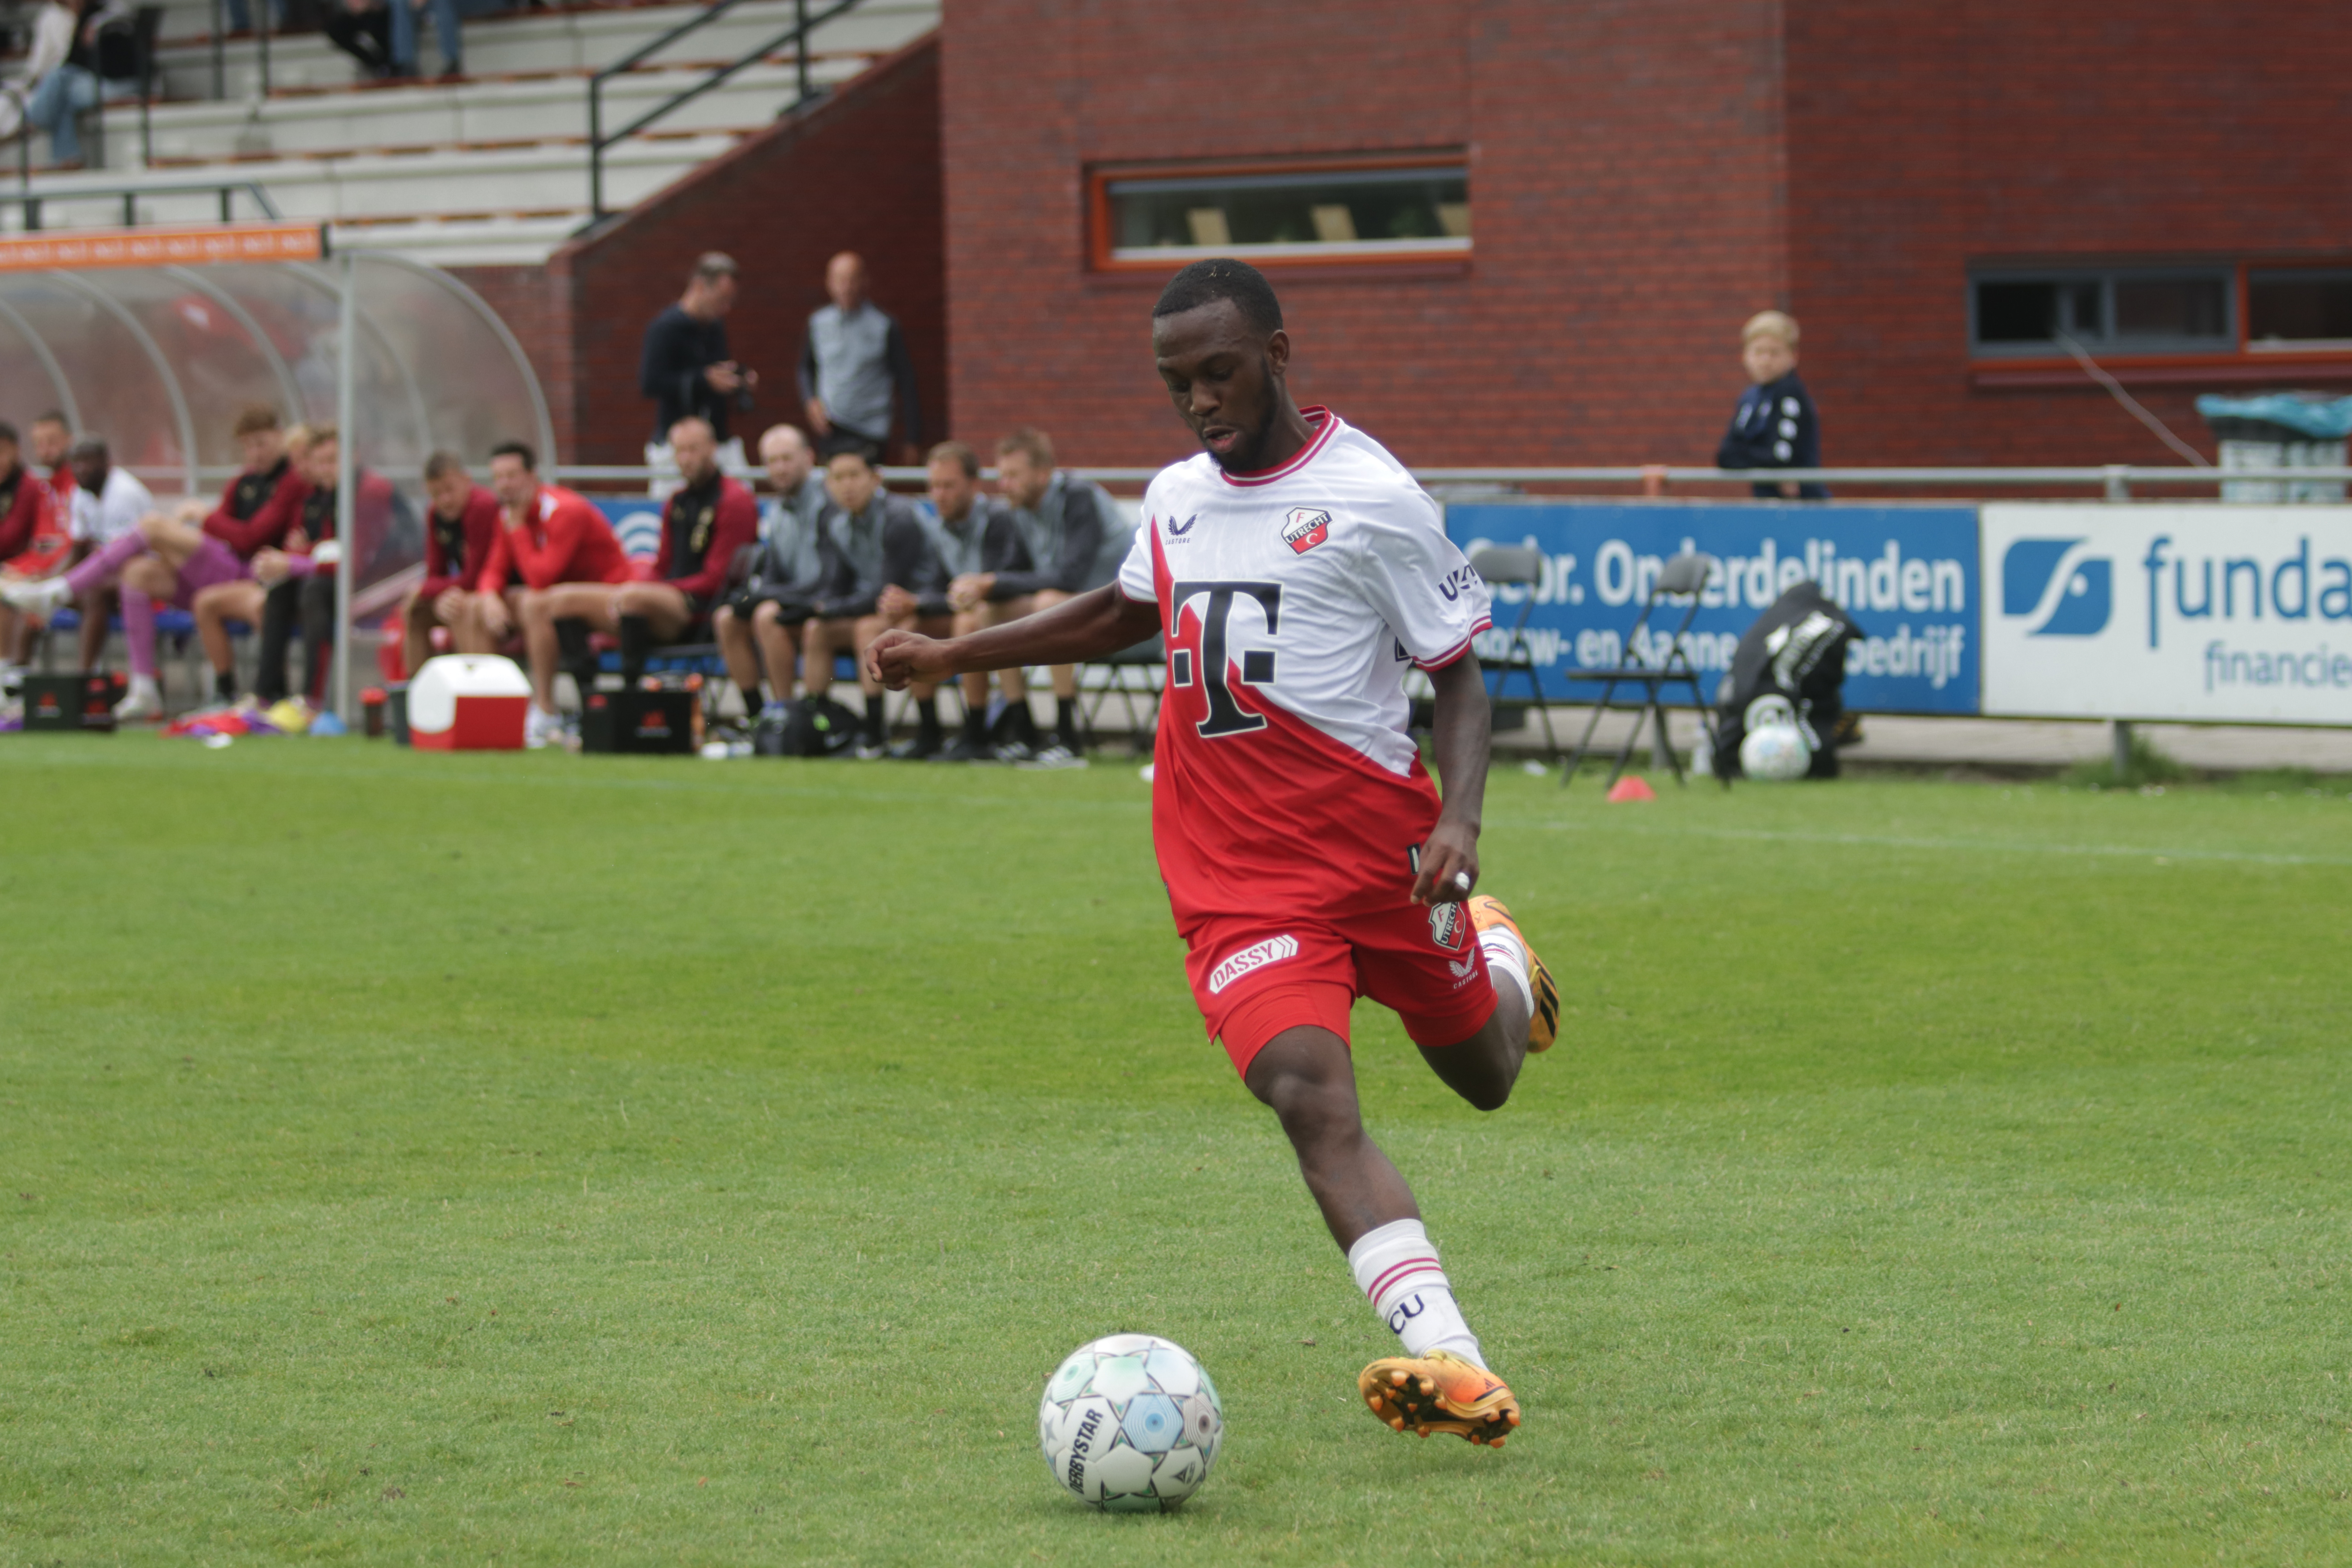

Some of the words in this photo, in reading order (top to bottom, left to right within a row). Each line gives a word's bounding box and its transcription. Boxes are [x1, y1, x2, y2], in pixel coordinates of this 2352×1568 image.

[1285, 514, 1329, 544] UTRECHT
[1296, 512, 1305, 523] F
[1306, 533, 1318, 544] C
[2142, 534, 2352, 651] funda
[1576, 628, 1622, 669] en
[1440, 901, 1458, 945] UTRECH
[1454, 920, 1462, 933] C
[1214, 942, 1273, 989] DASSY
[1453, 969, 1479, 989] CASTORE
[1068, 1408, 1103, 1495] DERBYSTAR
